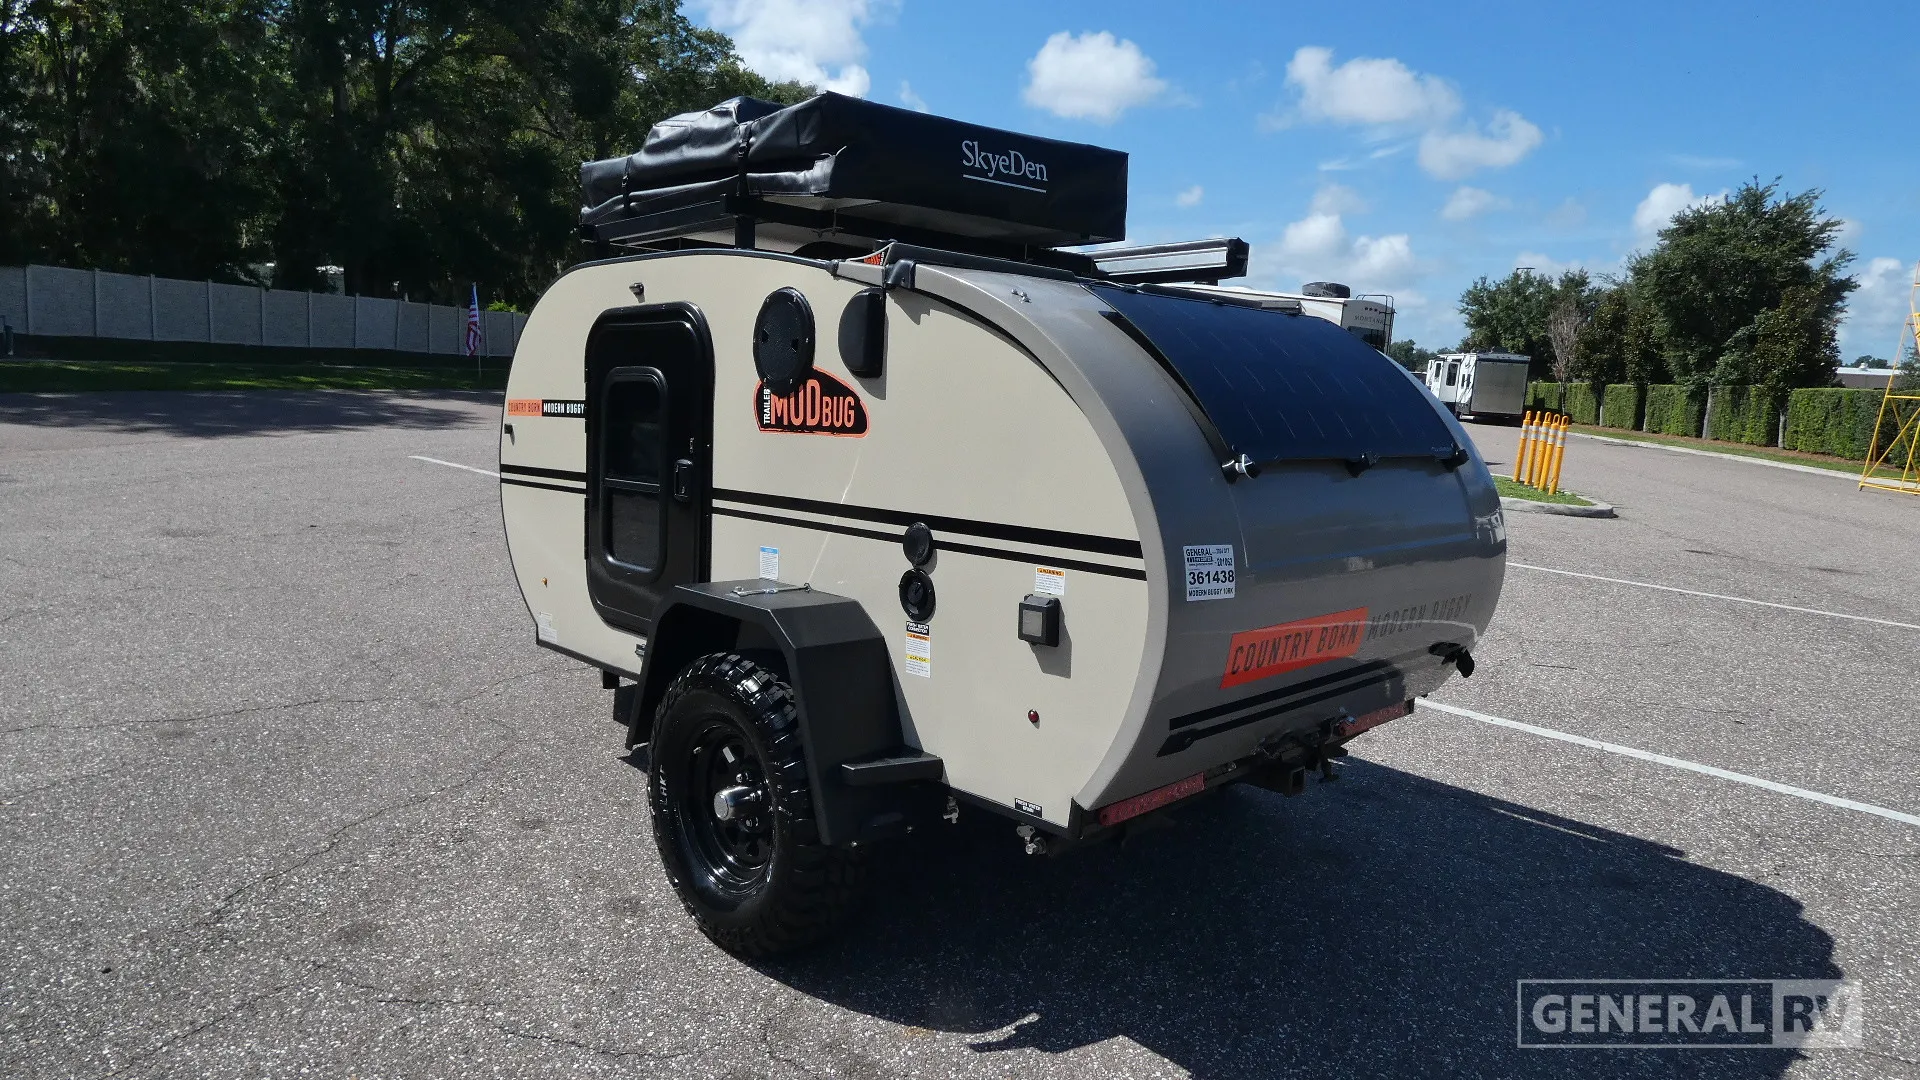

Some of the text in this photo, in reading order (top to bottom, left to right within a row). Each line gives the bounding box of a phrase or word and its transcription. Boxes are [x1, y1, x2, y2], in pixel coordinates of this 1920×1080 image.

[961, 140, 1048, 181] SkyeDen
[508, 402, 585, 414] COUNTRY BORN MODERN BUGGY
[1186, 548, 1212, 556] GENERAL
[1188, 570, 1235, 585] 361438
[1231, 594, 1472, 675] COUNTRY BORN MODERN BUGGY
